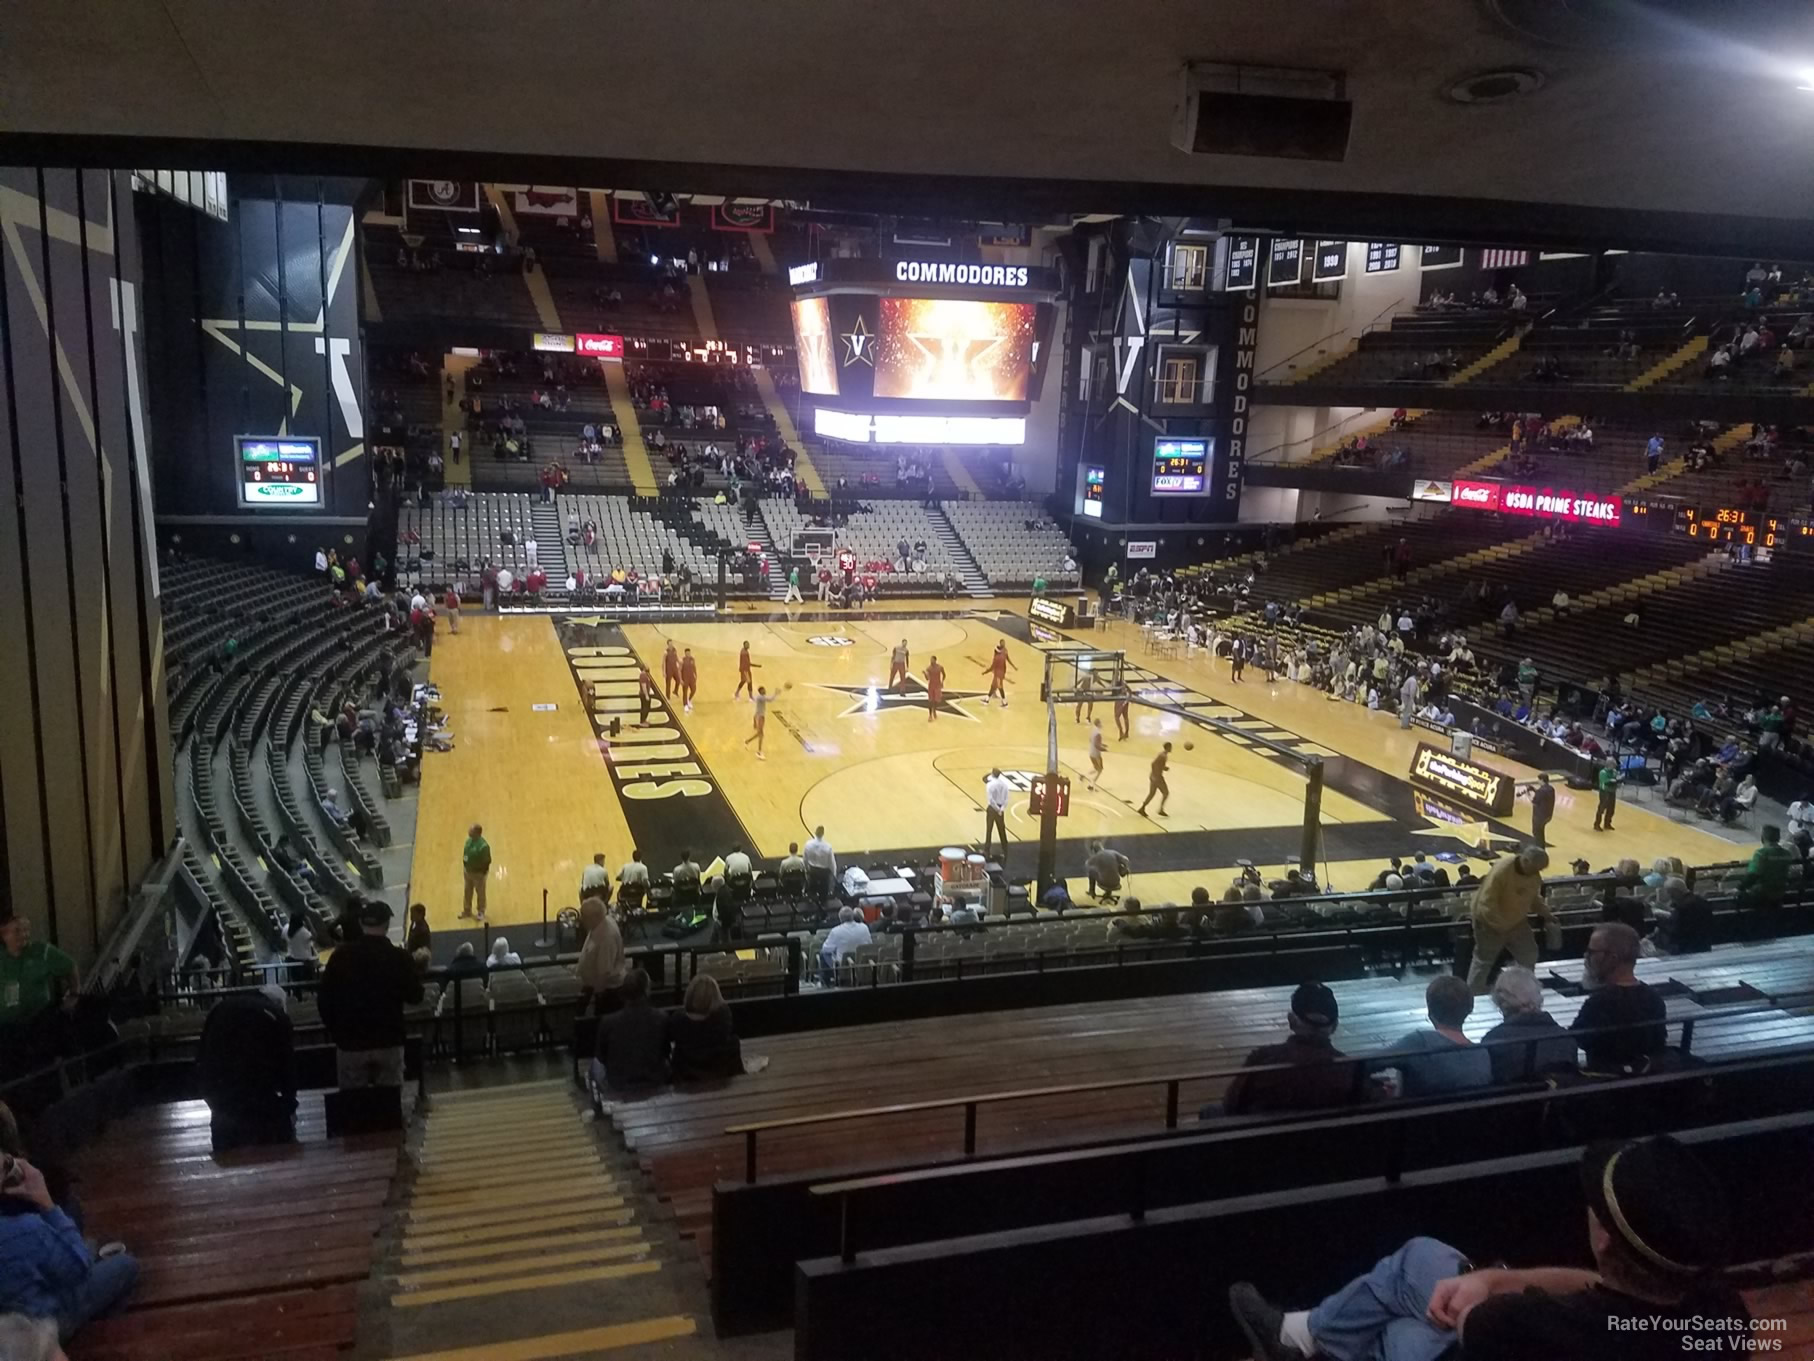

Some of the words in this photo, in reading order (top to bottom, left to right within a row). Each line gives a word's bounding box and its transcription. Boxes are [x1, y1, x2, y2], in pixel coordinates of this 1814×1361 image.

[897, 261, 1028, 286] COMMODORES
[1156, 477, 1171, 486] FOX
[1506, 492, 1533, 509] USDA
[1536, 494, 1571, 514] PRIME
[1687, 509, 1694, 520] 4
[1717, 509, 1745, 524] 26:31
[1690, 524, 1697, 536] 0
[1770, 519, 1777, 531] 4
[1710, 527, 1717, 539] 0
[1747, 532, 1754, 544] 0
[1767, 533, 1774, 546] 0
[1130, 544, 1154, 553] ESPN
